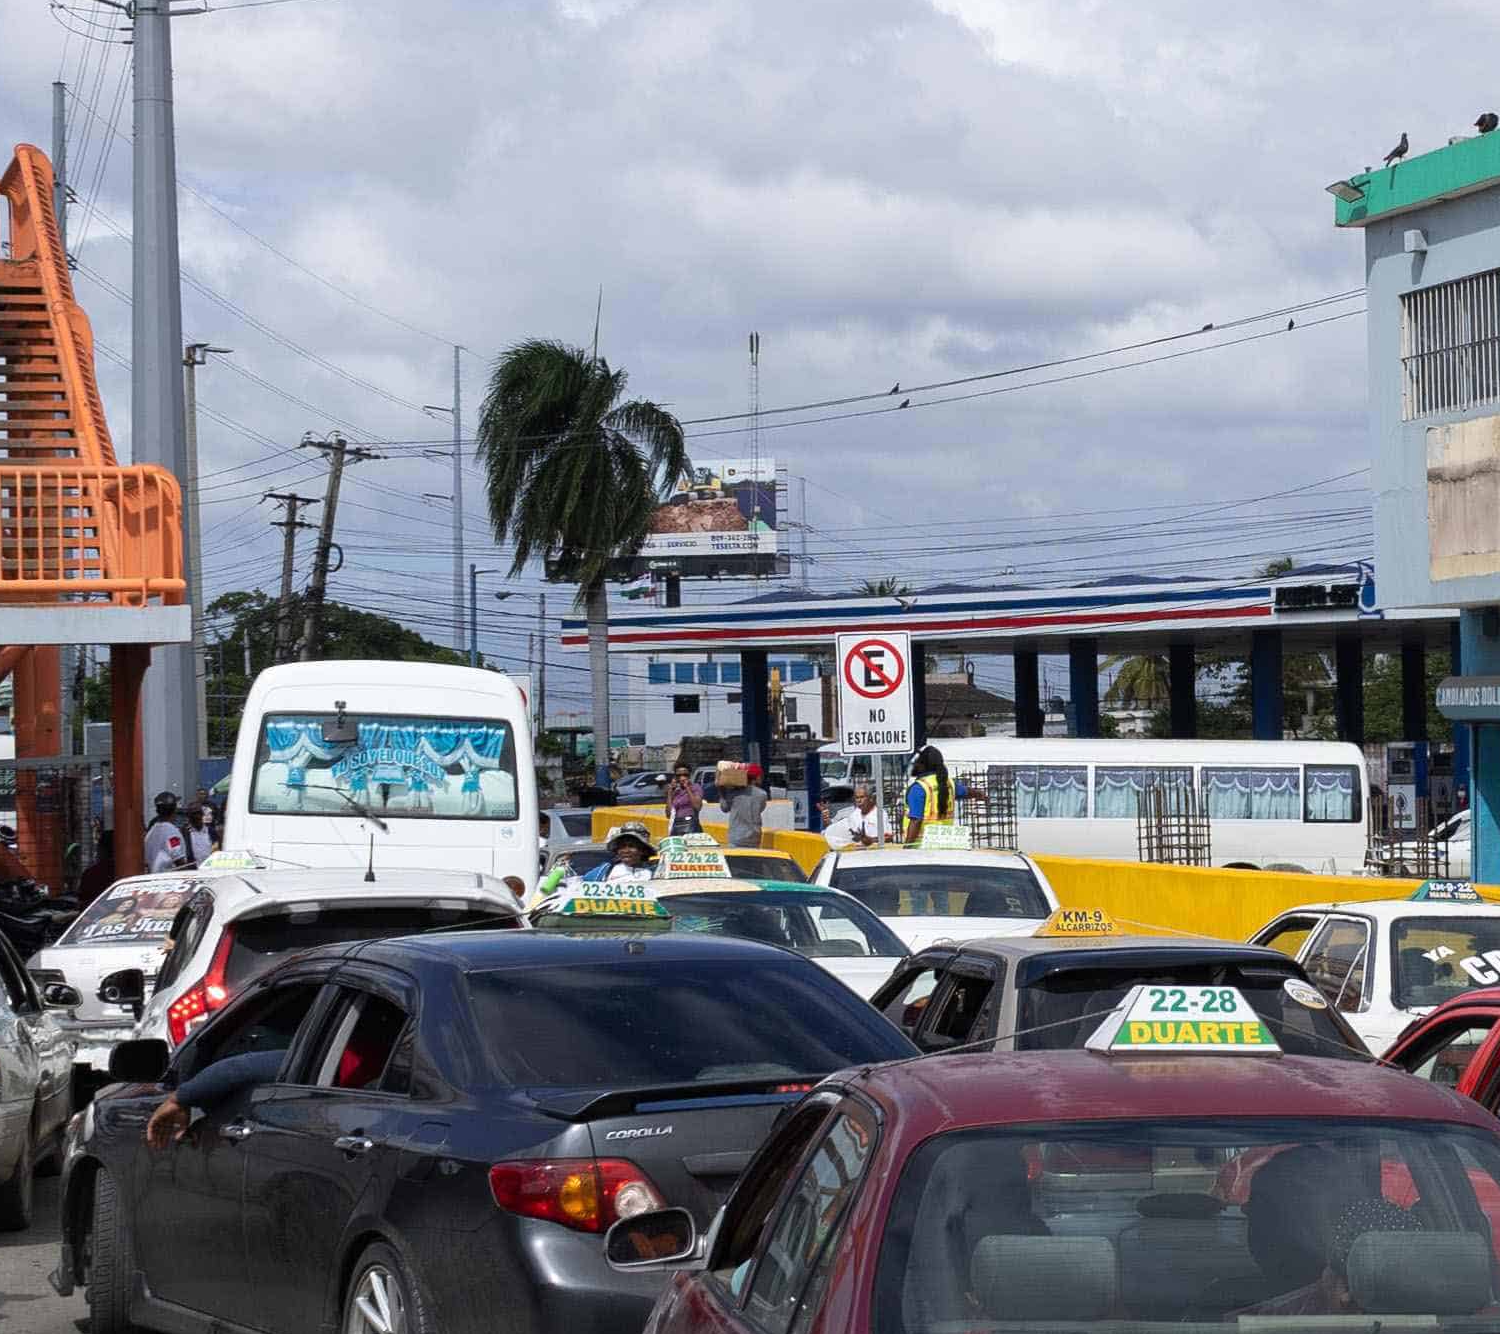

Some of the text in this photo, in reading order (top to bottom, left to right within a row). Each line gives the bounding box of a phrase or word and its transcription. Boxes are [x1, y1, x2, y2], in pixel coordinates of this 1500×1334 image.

[869, 709, 886, 723] NO
[847, 730, 907, 747] ESTACIONE
[582, 883, 645, 898] 22-24-28
[574, 897, 657, 916] DUARTE
[1062, 910, 1103, 924] KM-9
[1055, 922, 1113, 933] ALCARRIZOS
[1421, 944, 1456, 964] YA
[1149, 988, 1238, 1014] 22-28
[1128, 1020, 1262, 1045] DUARTE
[604, 1125, 673, 1140] COROLLA
